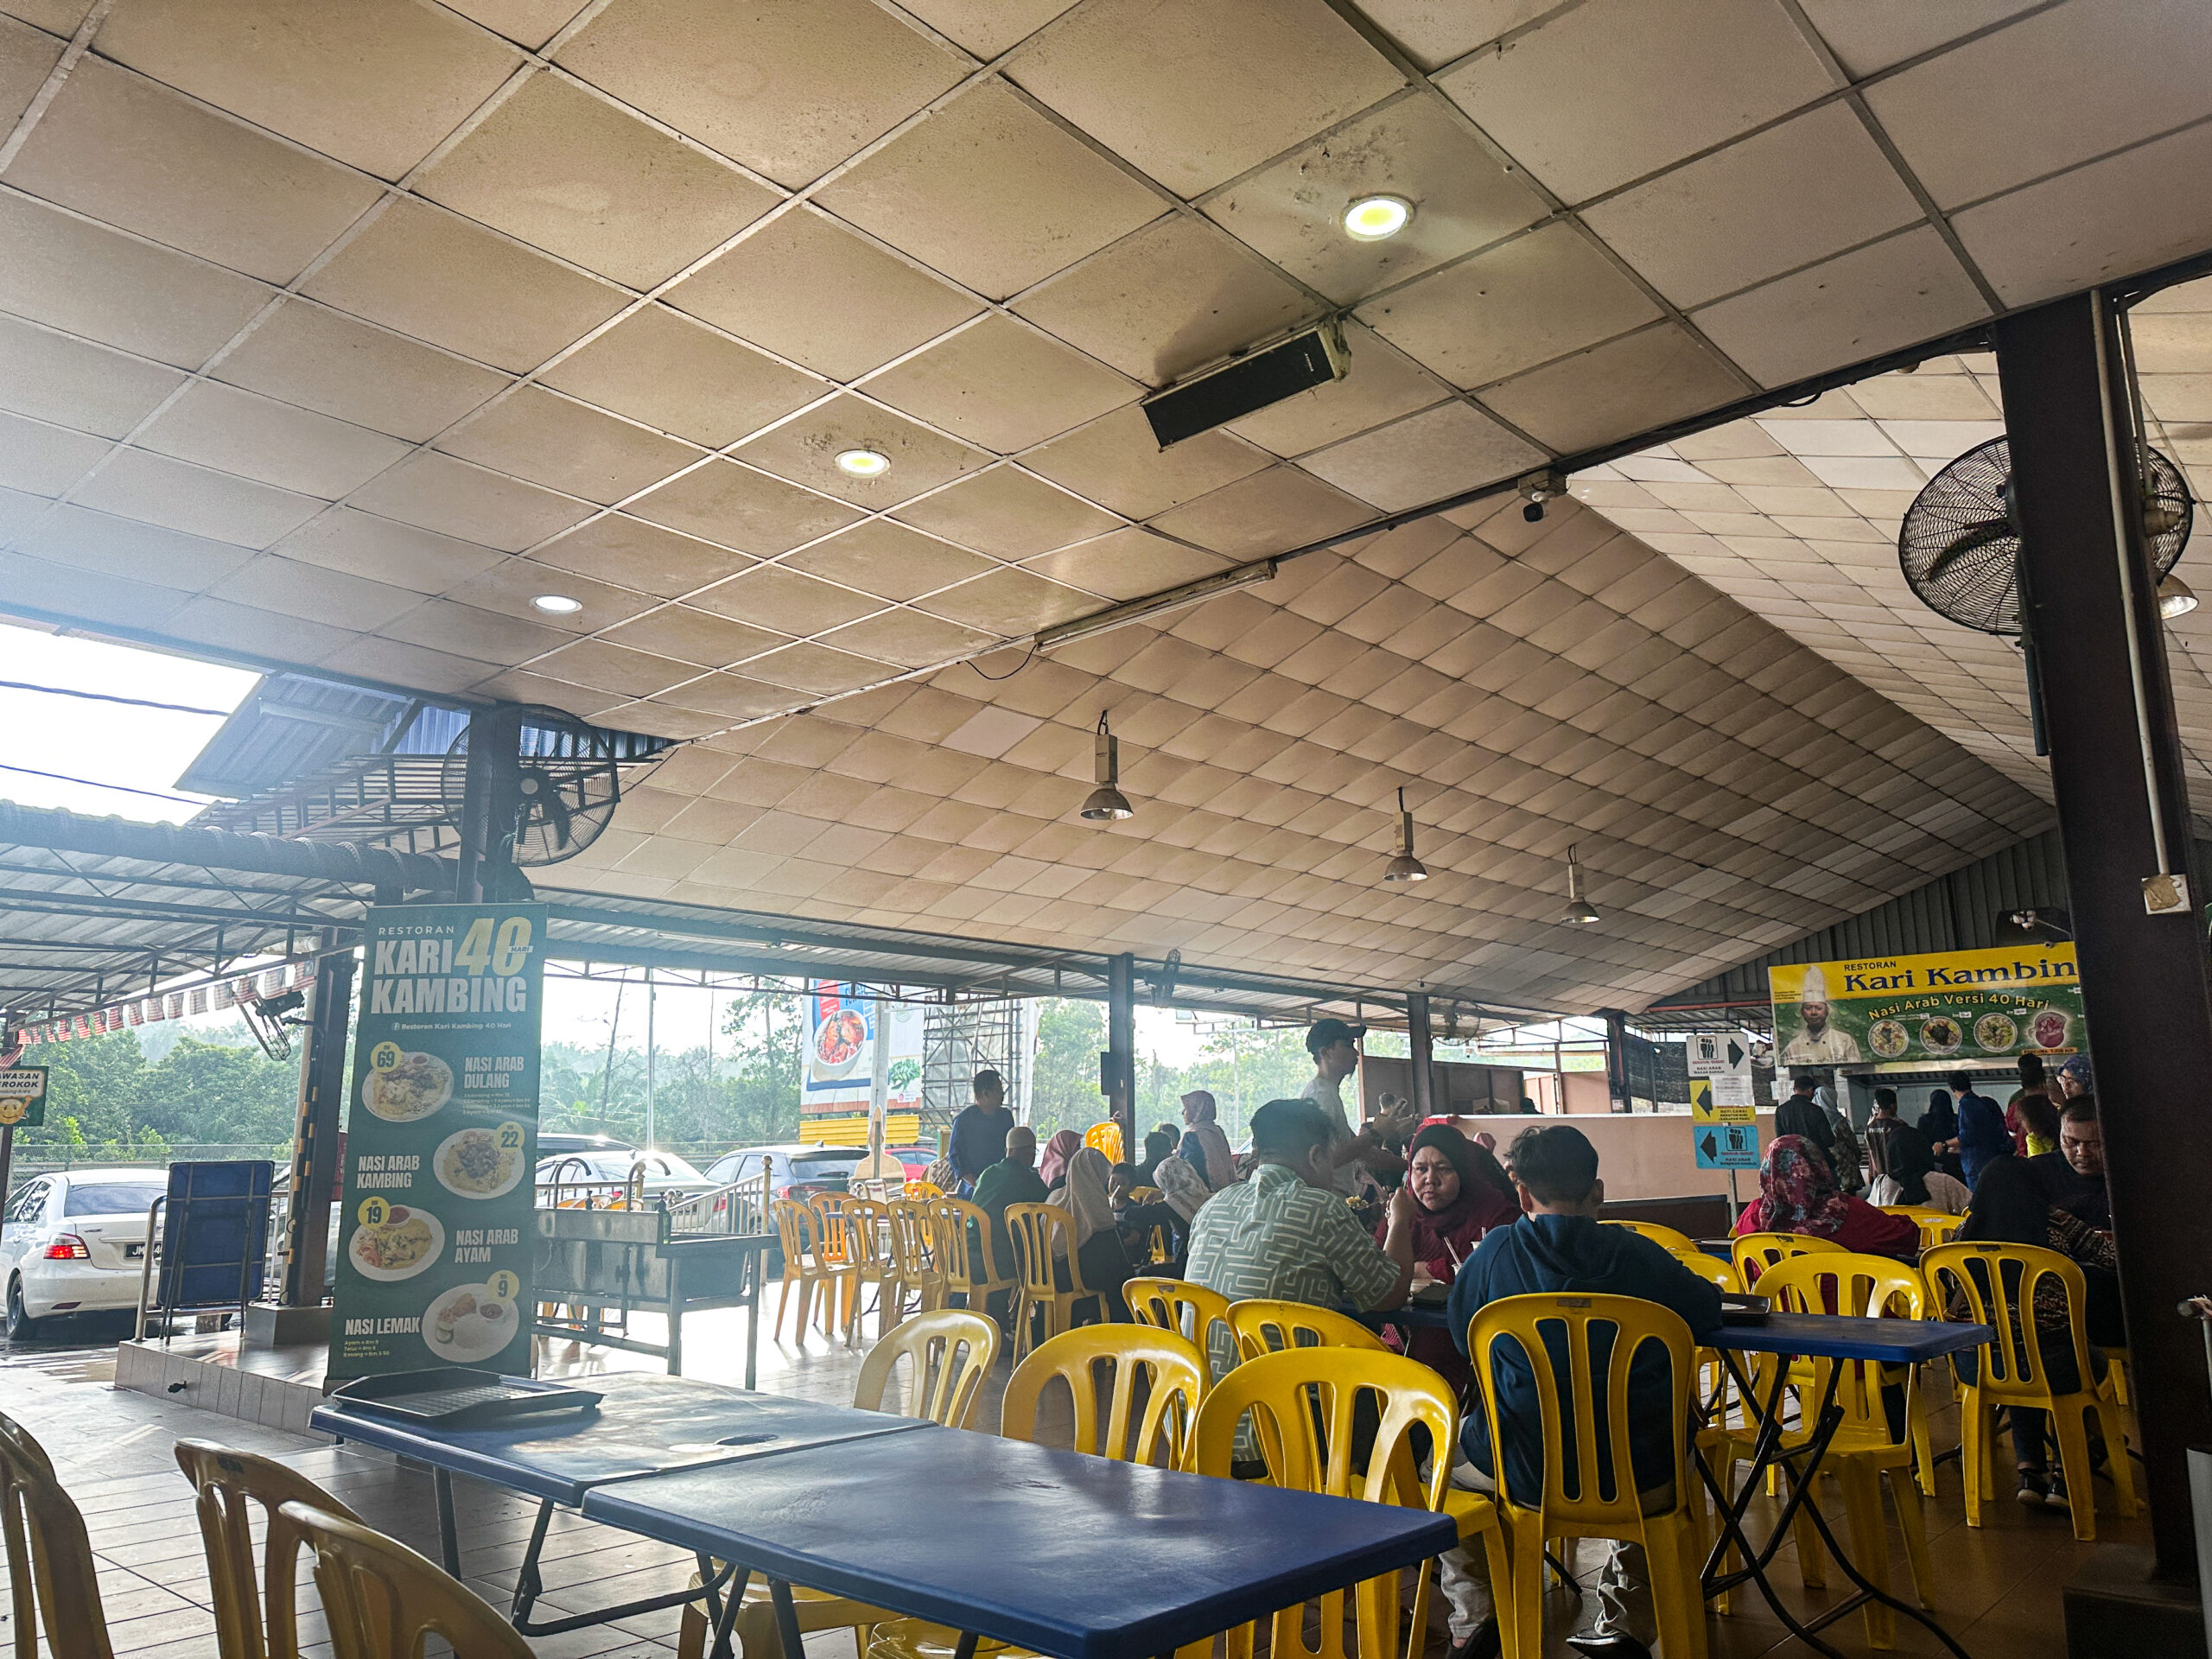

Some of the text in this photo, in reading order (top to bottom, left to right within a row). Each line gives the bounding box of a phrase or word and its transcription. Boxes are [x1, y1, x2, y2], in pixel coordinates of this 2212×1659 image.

[378, 925, 455, 936] RESTORAN
[454, 916, 532, 976] 40
[373, 939, 453, 975] KARI
[1844, 961, 1897, 971] RESTORAN
[1844, 969, 1915, 992] Kari
[371, 976, 527, 1014] KAMBING
[1868, 1002, 1900, 1021] Nasi
[1904, 996, 1940, 1012] Arab
[1943, 992, 1984, 1006] Versi
[1988, 994, 2011, 1005] 40
[2014, 995, 2050, 1011] Hari
[377, 1051, 396, 1068] 69
[464, 1056, 524, 1071] NASI ARAB
[464, 1073, 510, 1089] DULANG
[501, 1130, 518, 1148] 22
[358, 1155, 385, 1172] NASI
[387, 1154, 420, 1171] ARAB
[356, 1172, 413, 1189] KAMBING
[365, 1205, 382, 1224] 19
[455, 1229, 518, 1246] NASI ARAB
[454, 1247, 492, 1263] AYAM
[498, 1279, 508, 1298] 9
[345, 1317, 421, 1336] NASI LEMAK
